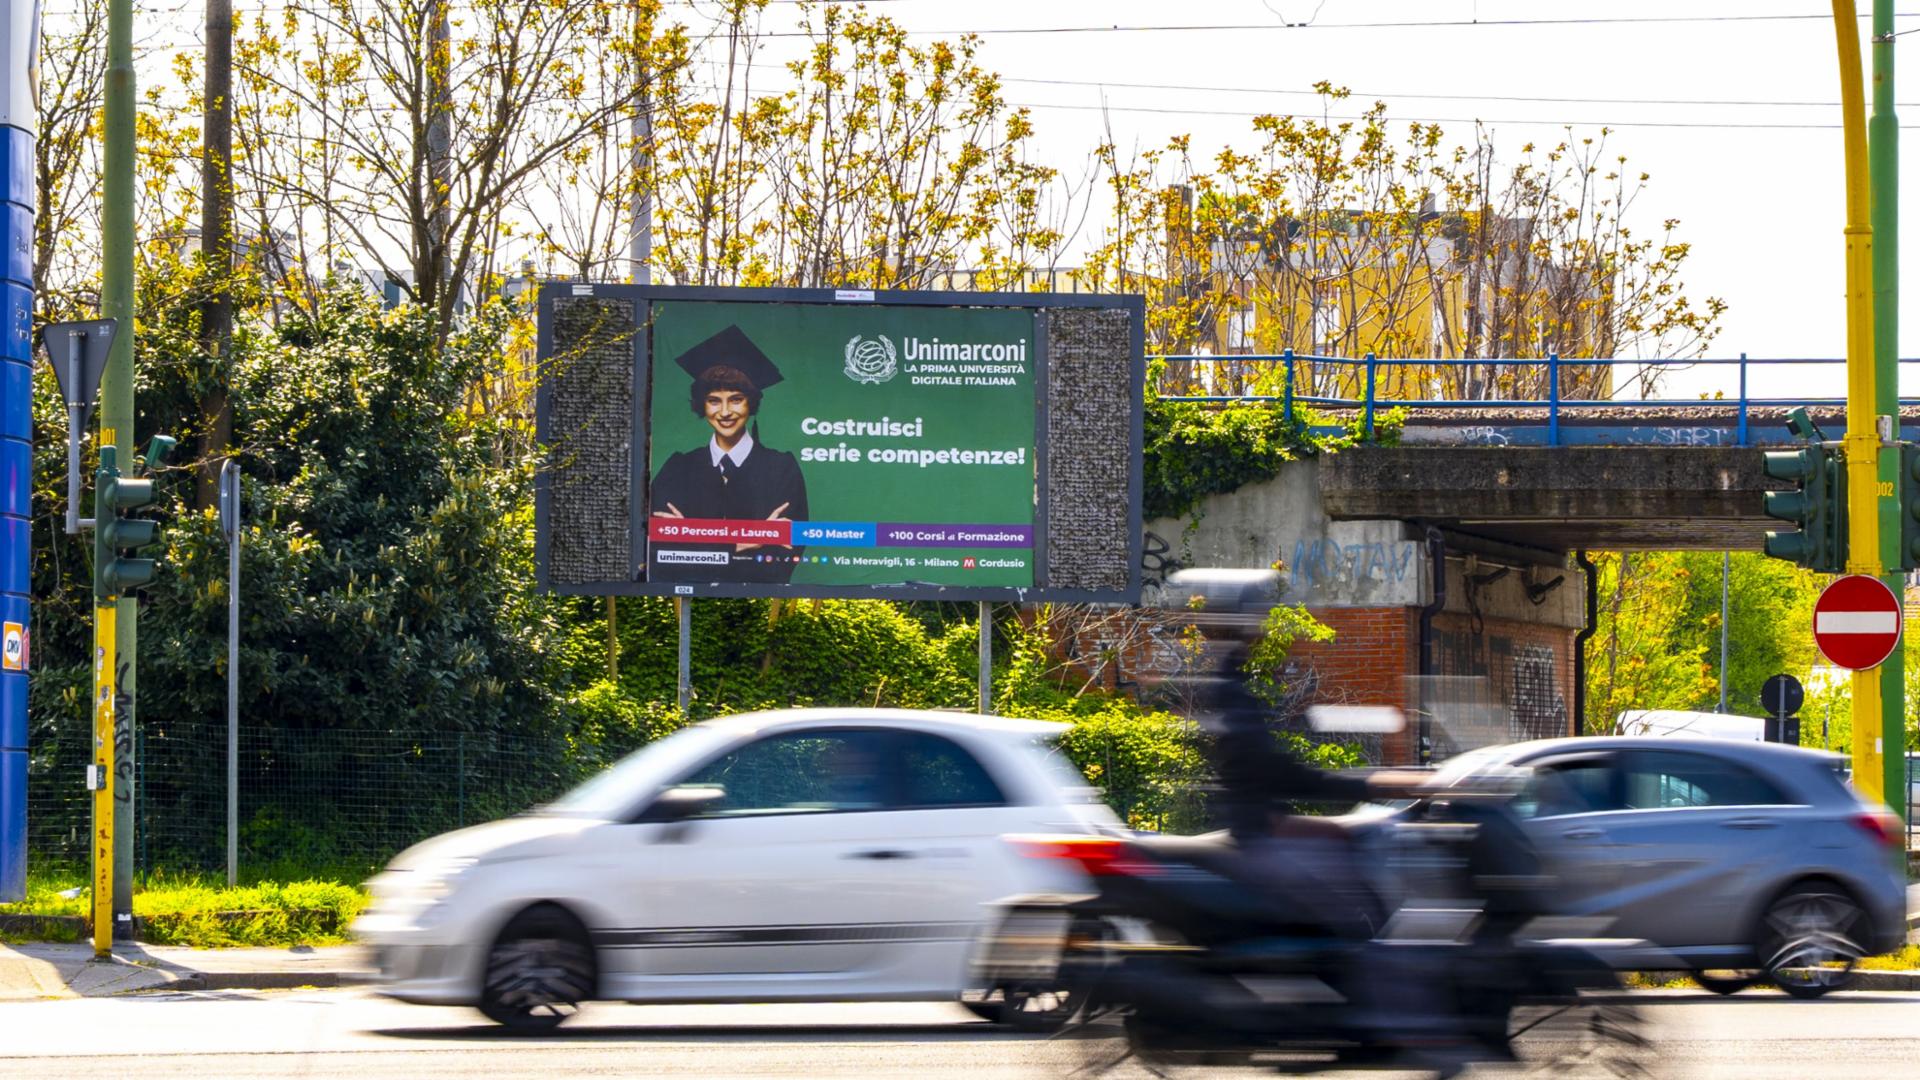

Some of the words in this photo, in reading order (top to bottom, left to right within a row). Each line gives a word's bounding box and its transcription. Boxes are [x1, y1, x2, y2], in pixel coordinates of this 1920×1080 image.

[904, 337, 1026, 361] Unimarconi
[904, 364, 917, 373] LA
[920, 365, 956, 373] PRIMA
[960, 363, 1025, 374] UNIVERSITÀ
[912, 376, 962, 385] DIGITALE
[965, 376, 1016, 386] ITALIANA
[801, 416, 923, 437] Costruisci
[800, 442, 861, 462] serie
[868, 447, 1026, 468] competenze!
[658, 526, 679, 536] +50
[682, 526, 728, 537] Percorsi
[741, 527, 780, 538] Laurea
[803, 528, 823, 538] +50
[826, 529, 866, 539] Master
[888, 531, 914, 540] +100
[916, 531, 945, 541] Corsi
[958, 532, 1025, 542] Formazione
[660, 553, 726, 563] unimarconi.it
[833, 556, 850, 565] Via
[853, 556, 903, 567] Meravigli,
[905, 558, 916, 566] 16
[924, 557, 959, 567] Milano
[979, 558, 1025, 568] Cordusio
